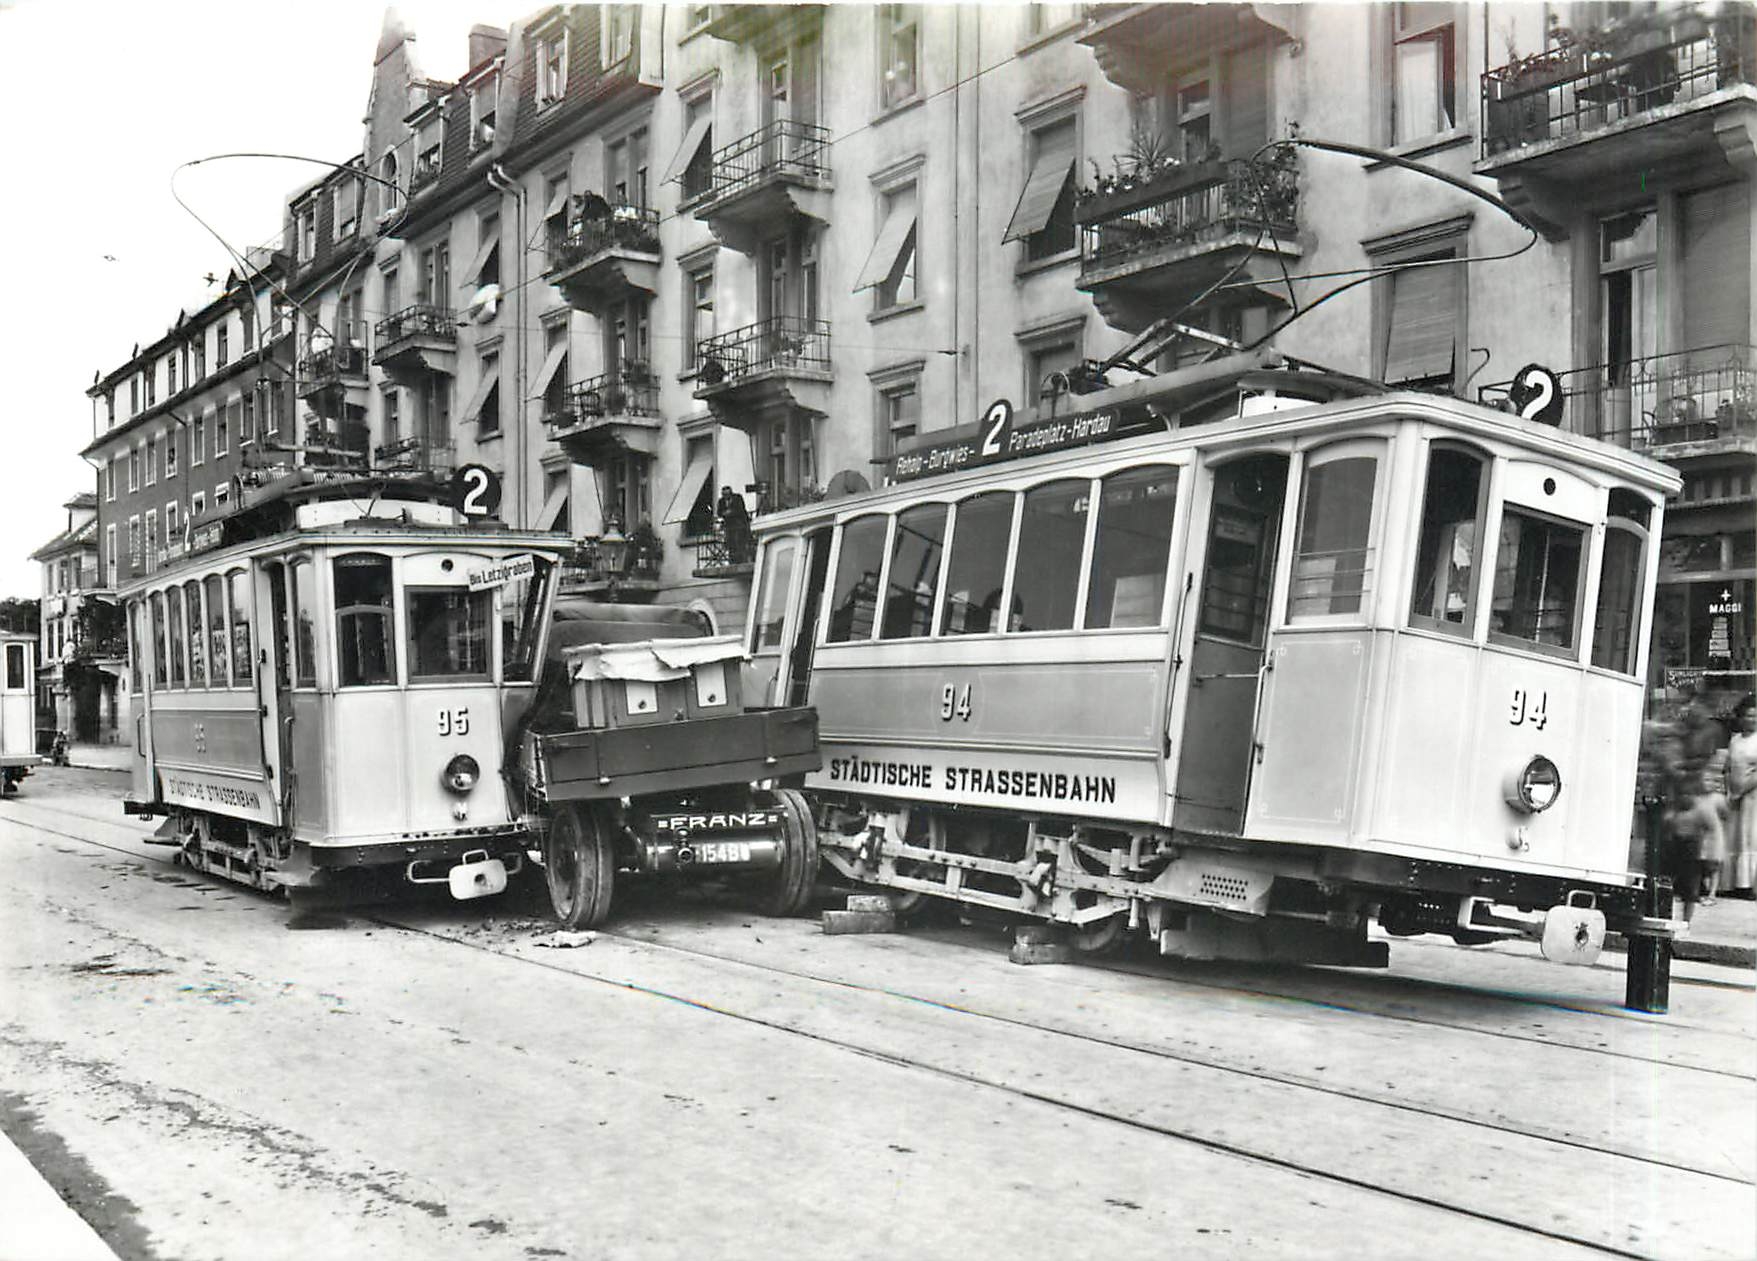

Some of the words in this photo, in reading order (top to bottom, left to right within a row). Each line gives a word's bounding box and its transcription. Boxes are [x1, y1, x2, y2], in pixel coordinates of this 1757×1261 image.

[1521, 370, 1553, 420] 2
[982, 404, 1007, 456] 2
[464, 468, 488, 514] 2
[183, 511, 191, 552] 2
[1709, 602, 1741, 613] MAGGI
[439, 706, 469, 736] 95
[941, 683, 972, 721] 94
[1510, 688, 1547, 731] 94
[831, 755, 932, 789] STÄDTISCHE
[945, 767, 1116, 804] STRASSENBAHN
